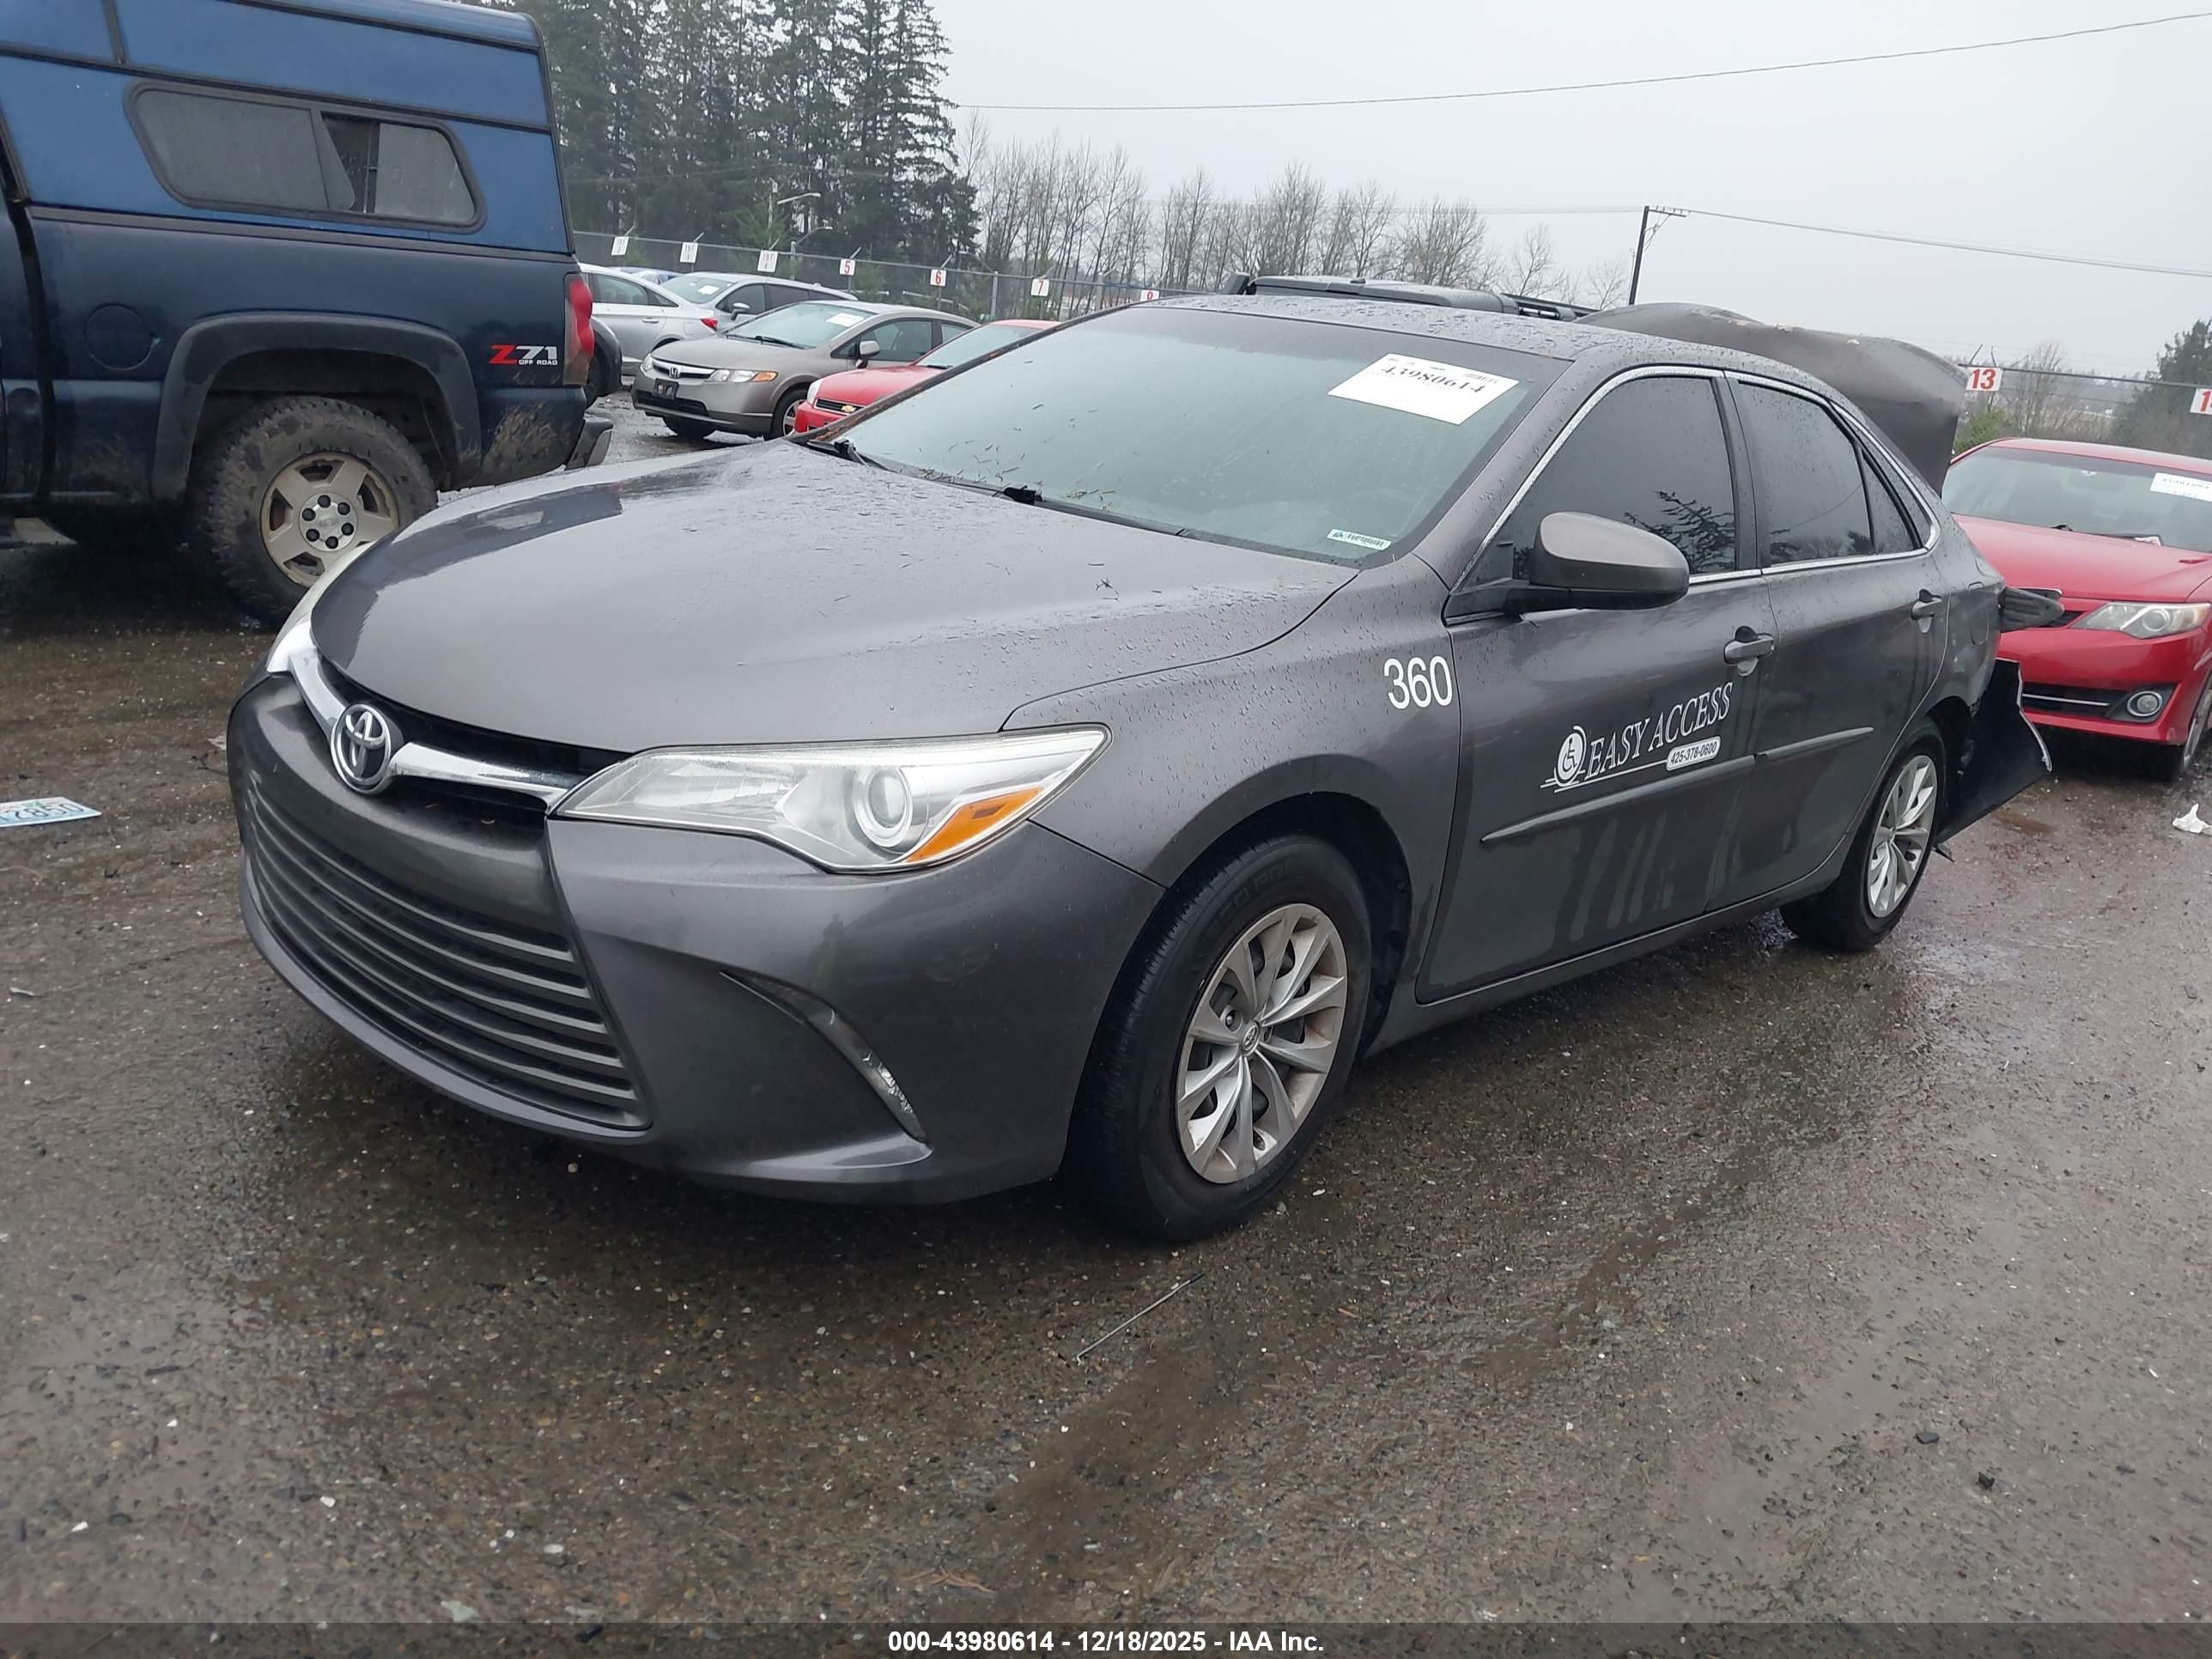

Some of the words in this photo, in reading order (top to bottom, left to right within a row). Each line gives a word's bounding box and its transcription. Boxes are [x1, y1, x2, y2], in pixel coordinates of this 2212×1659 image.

[844, 260, 851, 274] 5
[934, 270, 942, 284] 6
[1037, 280, 1045, 295] 7
[489, 344, 558, 365] Z71
[1972, 368, 1996, 389] 13
[2200, 391, 2212, 412] 1
[1383, 655, 1453, 709] 360
[1584, 717, 1650, 781] EASY
[1647, 681, 1734, 752] ACCESS
[1670, 740, 1718, 764] 425-378-0600
